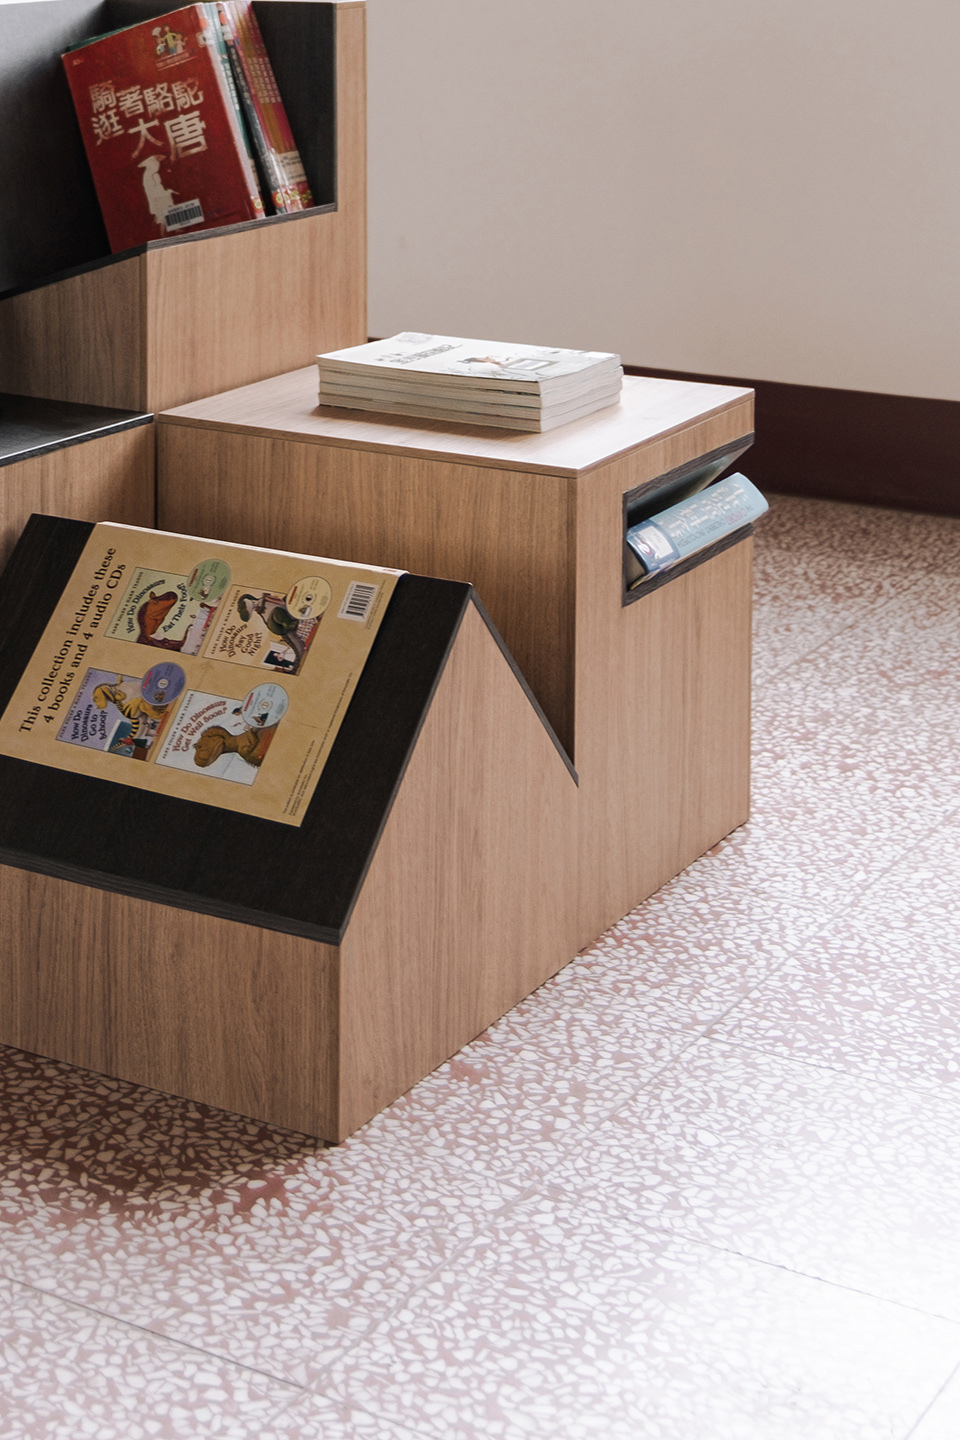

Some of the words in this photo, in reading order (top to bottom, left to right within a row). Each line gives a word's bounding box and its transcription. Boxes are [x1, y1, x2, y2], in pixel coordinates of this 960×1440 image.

[88, 78, 204, 118] 騎著駱駝
[91, 110, 208, 162] 逛大唐
[106, 564, 126, 590] CDs
[135, 579, 165, 604] Dinosaurs
[90, 593, 112, 628] audio
[127, 605, 136, 616] Do
[162, 622, 175, 632] Eat
[172, 603, 186, 621] Their
[82, 631, 93, 640] 4
[126, 616, 135, 634] How
[19, 705, 41, 733] This
[37, 638, 73, 702] collection
[66, 584, 100, 636] includes
[94, 548, 116, 581] these
[220, 635, 228, 652] How
[226, 625, 236, 635] Do
[227, 624, 248, 657] Dinosaurs
[235, 635, 245, 648] Say
[241, 633, 254, 654] Good
[248, 632, 262, 656] Night?
[71, 644, 88, 668] and
[48, 672, 75, 710] books
[43, 715, 54, 724] 4
[73, 710, 83, 721] Do
[81, 704, 93, 742] Dinosaurs
[90, 714, 98, 724] to
[172, 735, 183, 752] How
[181, 722, 192, 733] Do
[190, 701, 226, 724] Dinosaurs
[71, 722, 80, 740] How
[89, 724, 97, 737] Go
[181, 739, 191, 752] Get
[188, 722, 203, 737] Well
